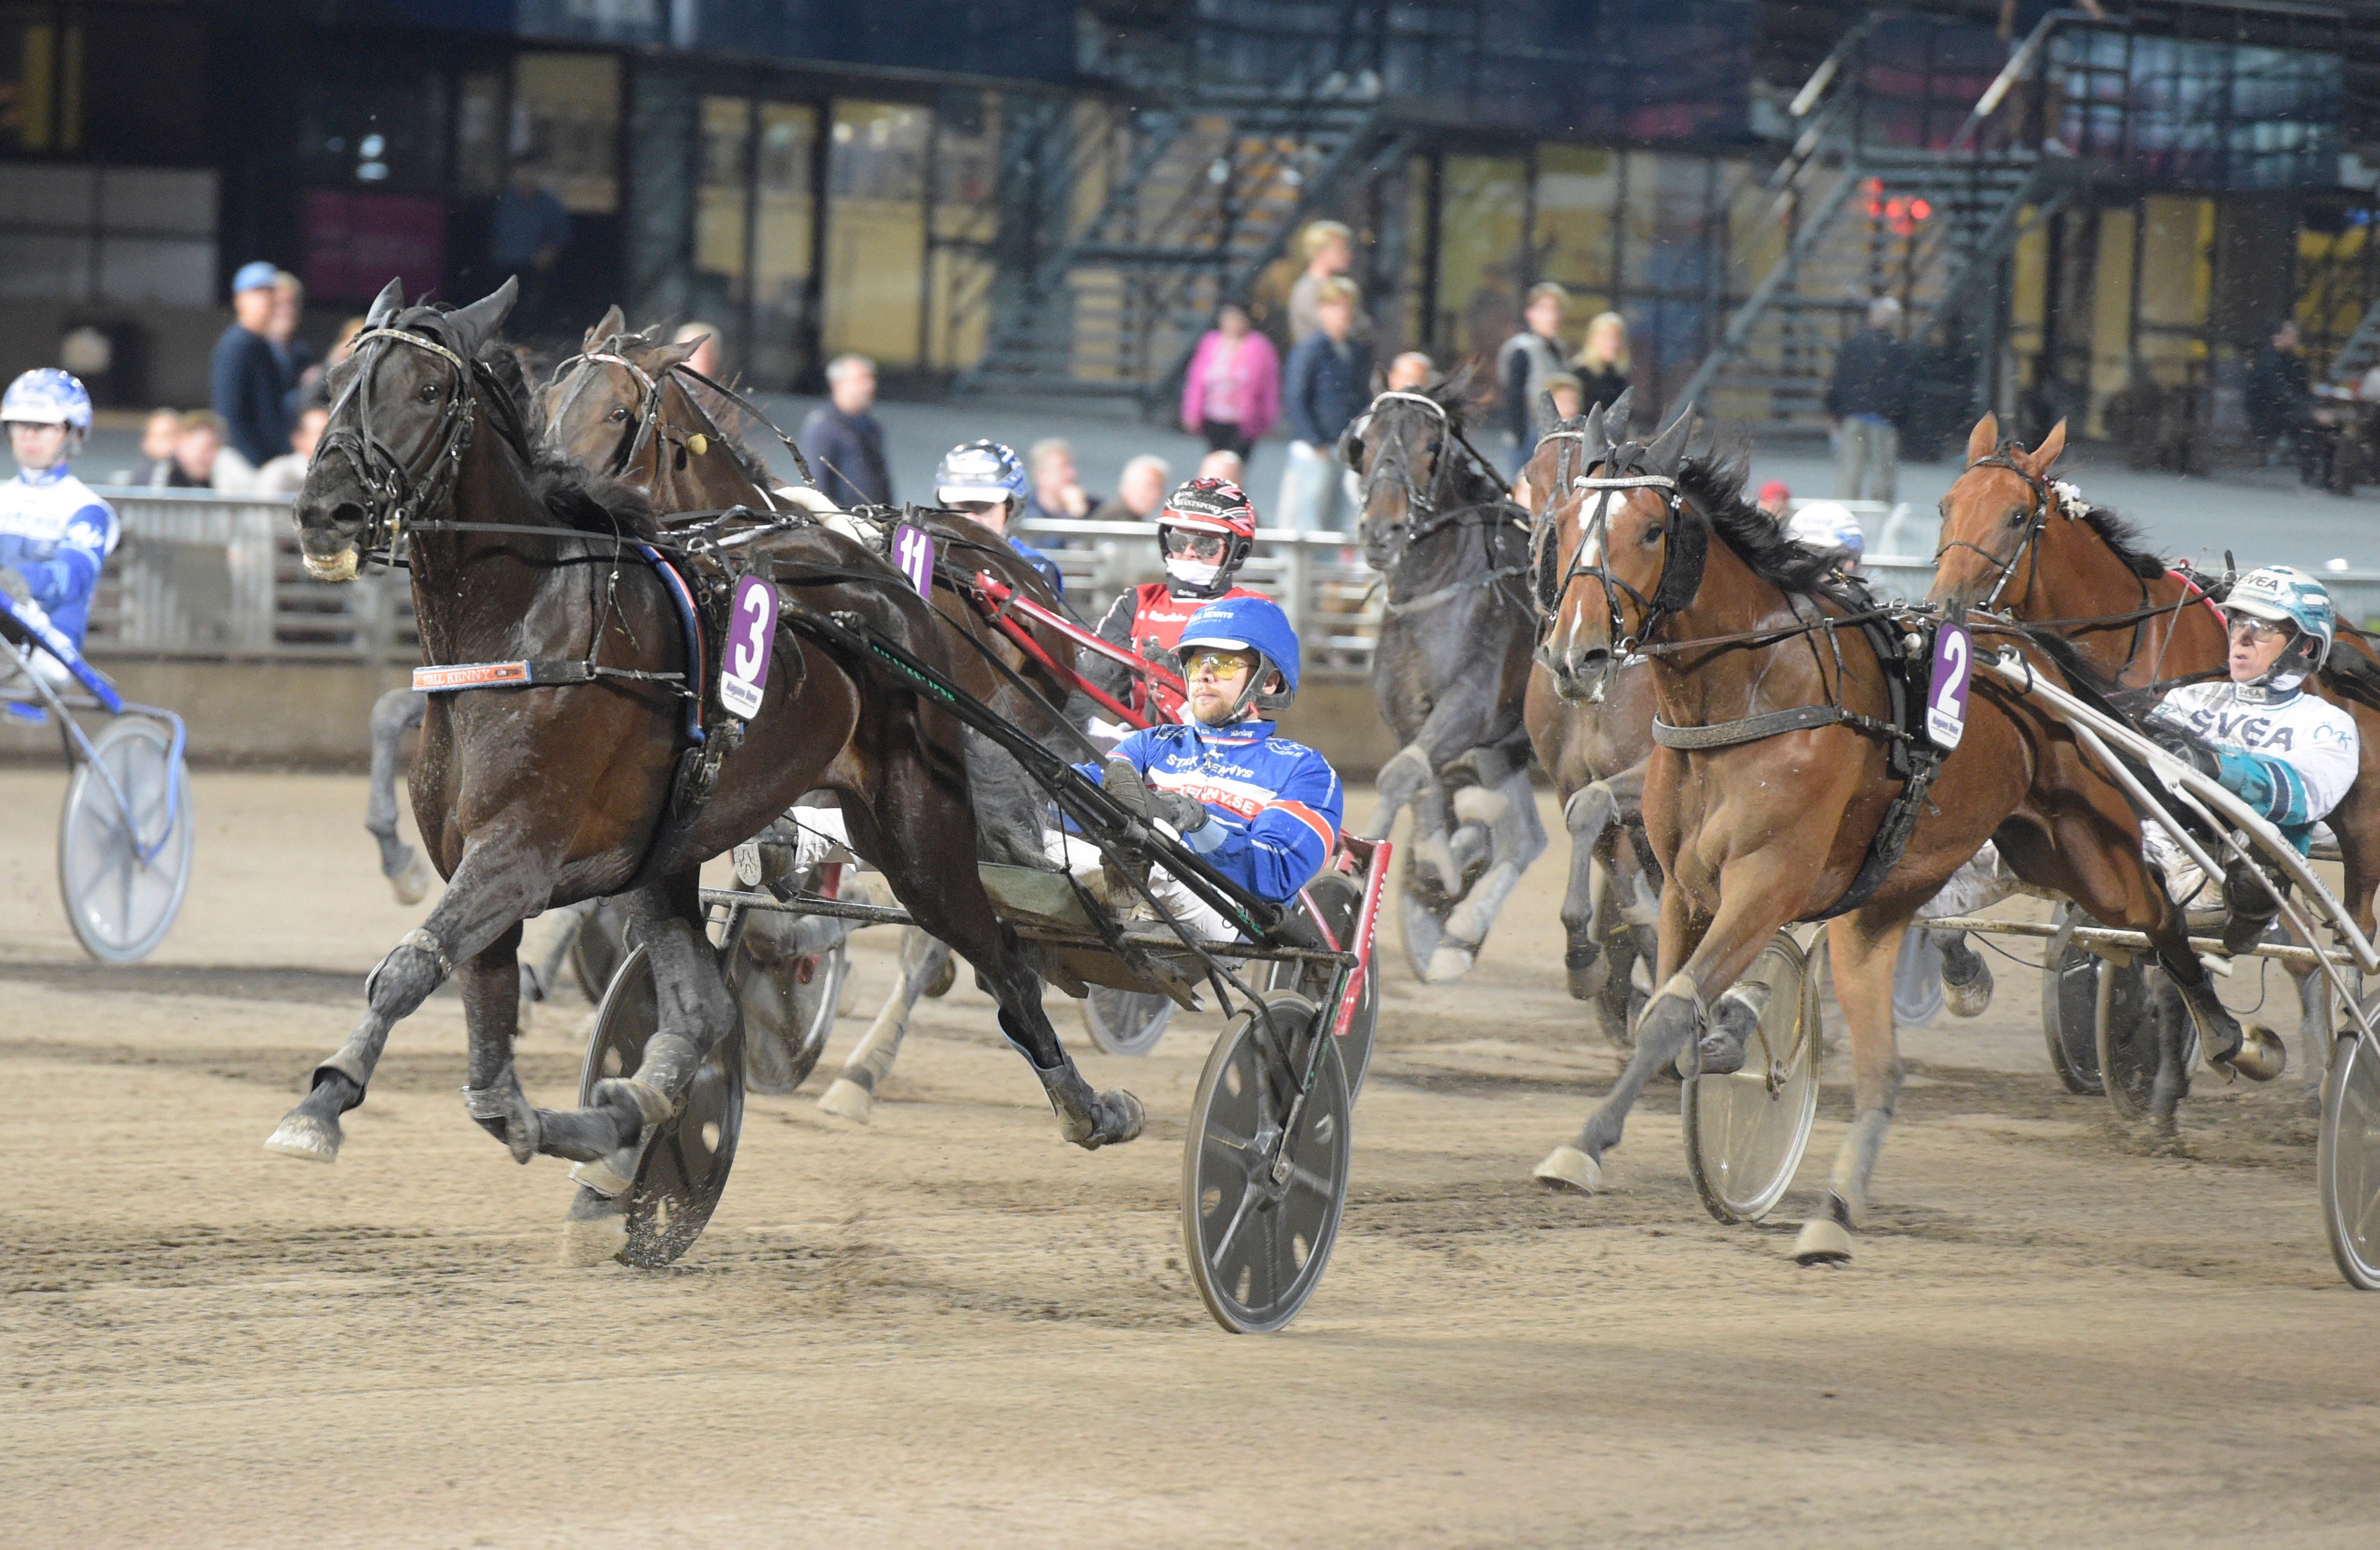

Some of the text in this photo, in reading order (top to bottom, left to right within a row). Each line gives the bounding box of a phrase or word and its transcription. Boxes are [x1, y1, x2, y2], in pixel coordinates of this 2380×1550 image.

[900, 528, 927, 594] 11
[735, 584, 770, 682] 3
[446, 669, 491, 684] KENNY
[1936, 630, 1967, 719] 2
[2239, 687, 2262, 697] SVEA
[2185, 709, 2294, 752] SVEA
[1204, 760, 1255, 778] ENNYS
